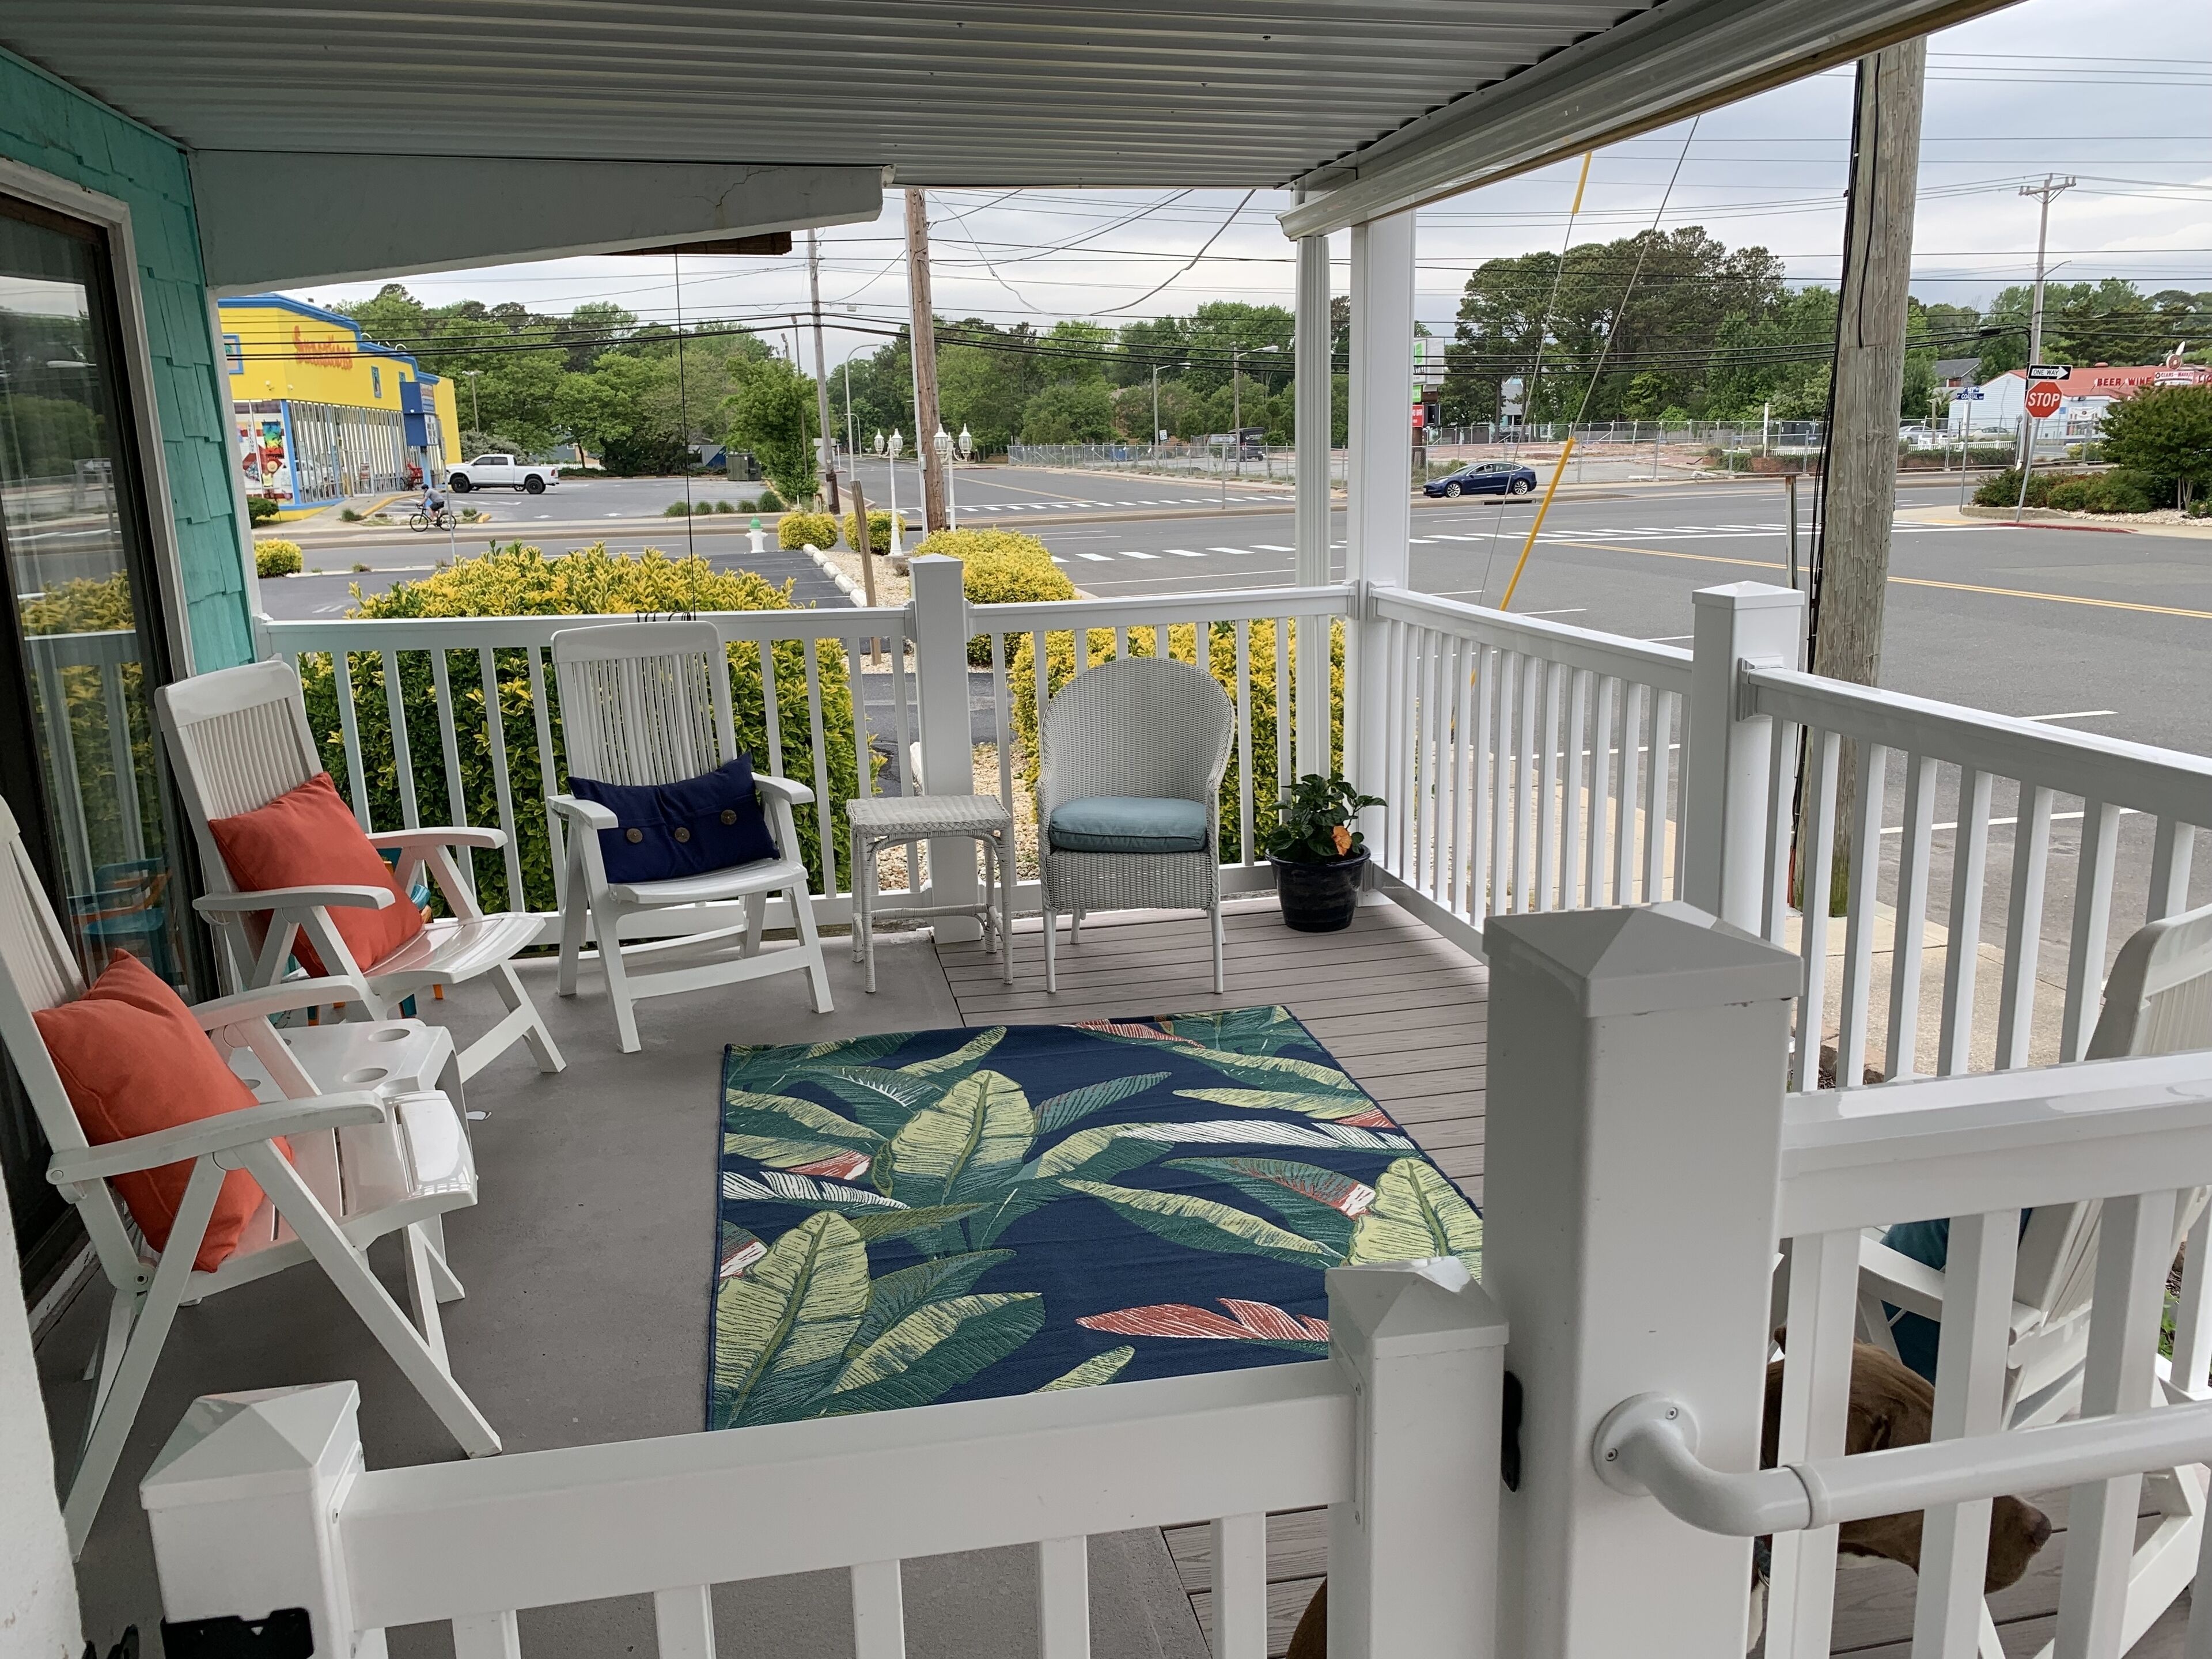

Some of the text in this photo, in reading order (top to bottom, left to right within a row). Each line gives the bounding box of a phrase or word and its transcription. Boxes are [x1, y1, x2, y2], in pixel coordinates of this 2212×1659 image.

[2097, 378, 2121, 387] BEER
[2128, 377, 2152, 386] WINE
[2028, 392, 2061, 407] STOP
